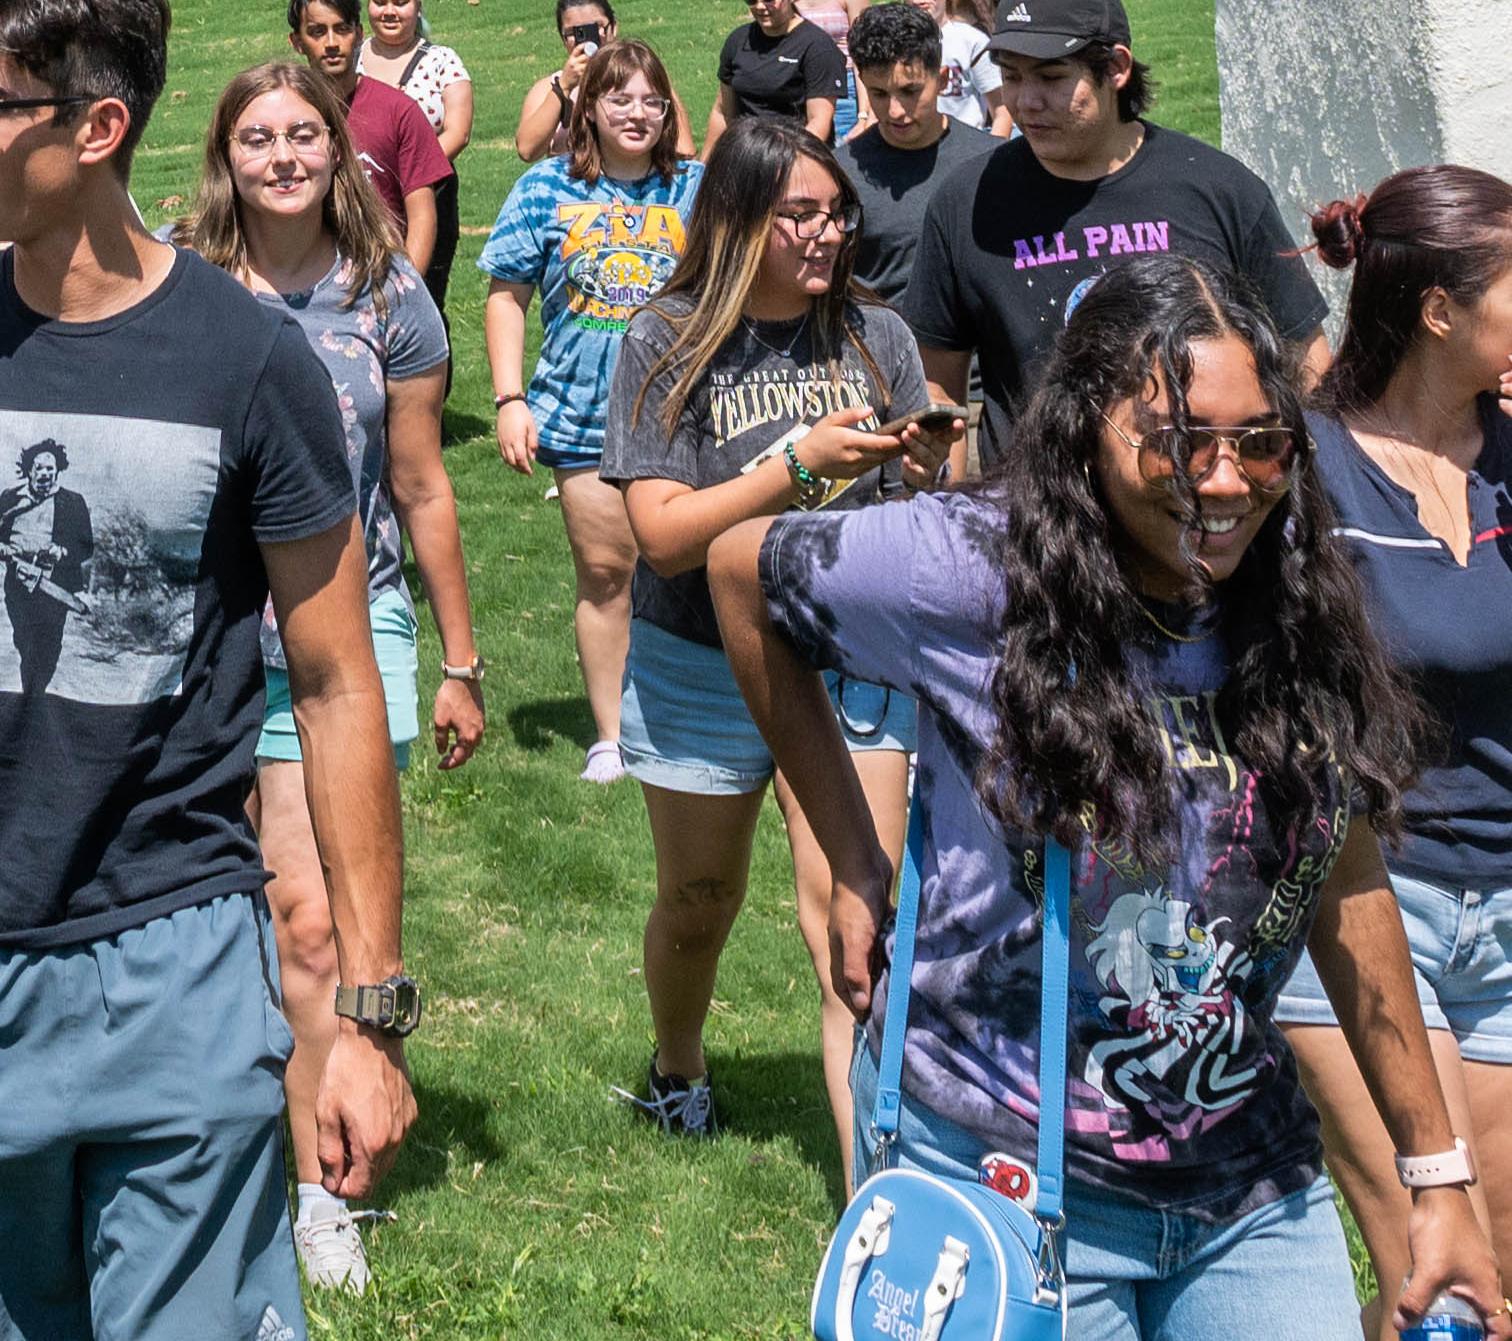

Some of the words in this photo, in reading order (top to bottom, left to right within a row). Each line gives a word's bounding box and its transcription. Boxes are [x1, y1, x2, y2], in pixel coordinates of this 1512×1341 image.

[1013, 232, 1079, 270] ALL
[1082, 220, 1169, 259] PAIN
[607, 286, 646, 303] 2019
[711, 372, 736, 386] THE
[743, 369, 788, 384] GREAT
[868, 1269, 919, 1317] Angel
[872, 1302, 922, 1341] Drea
